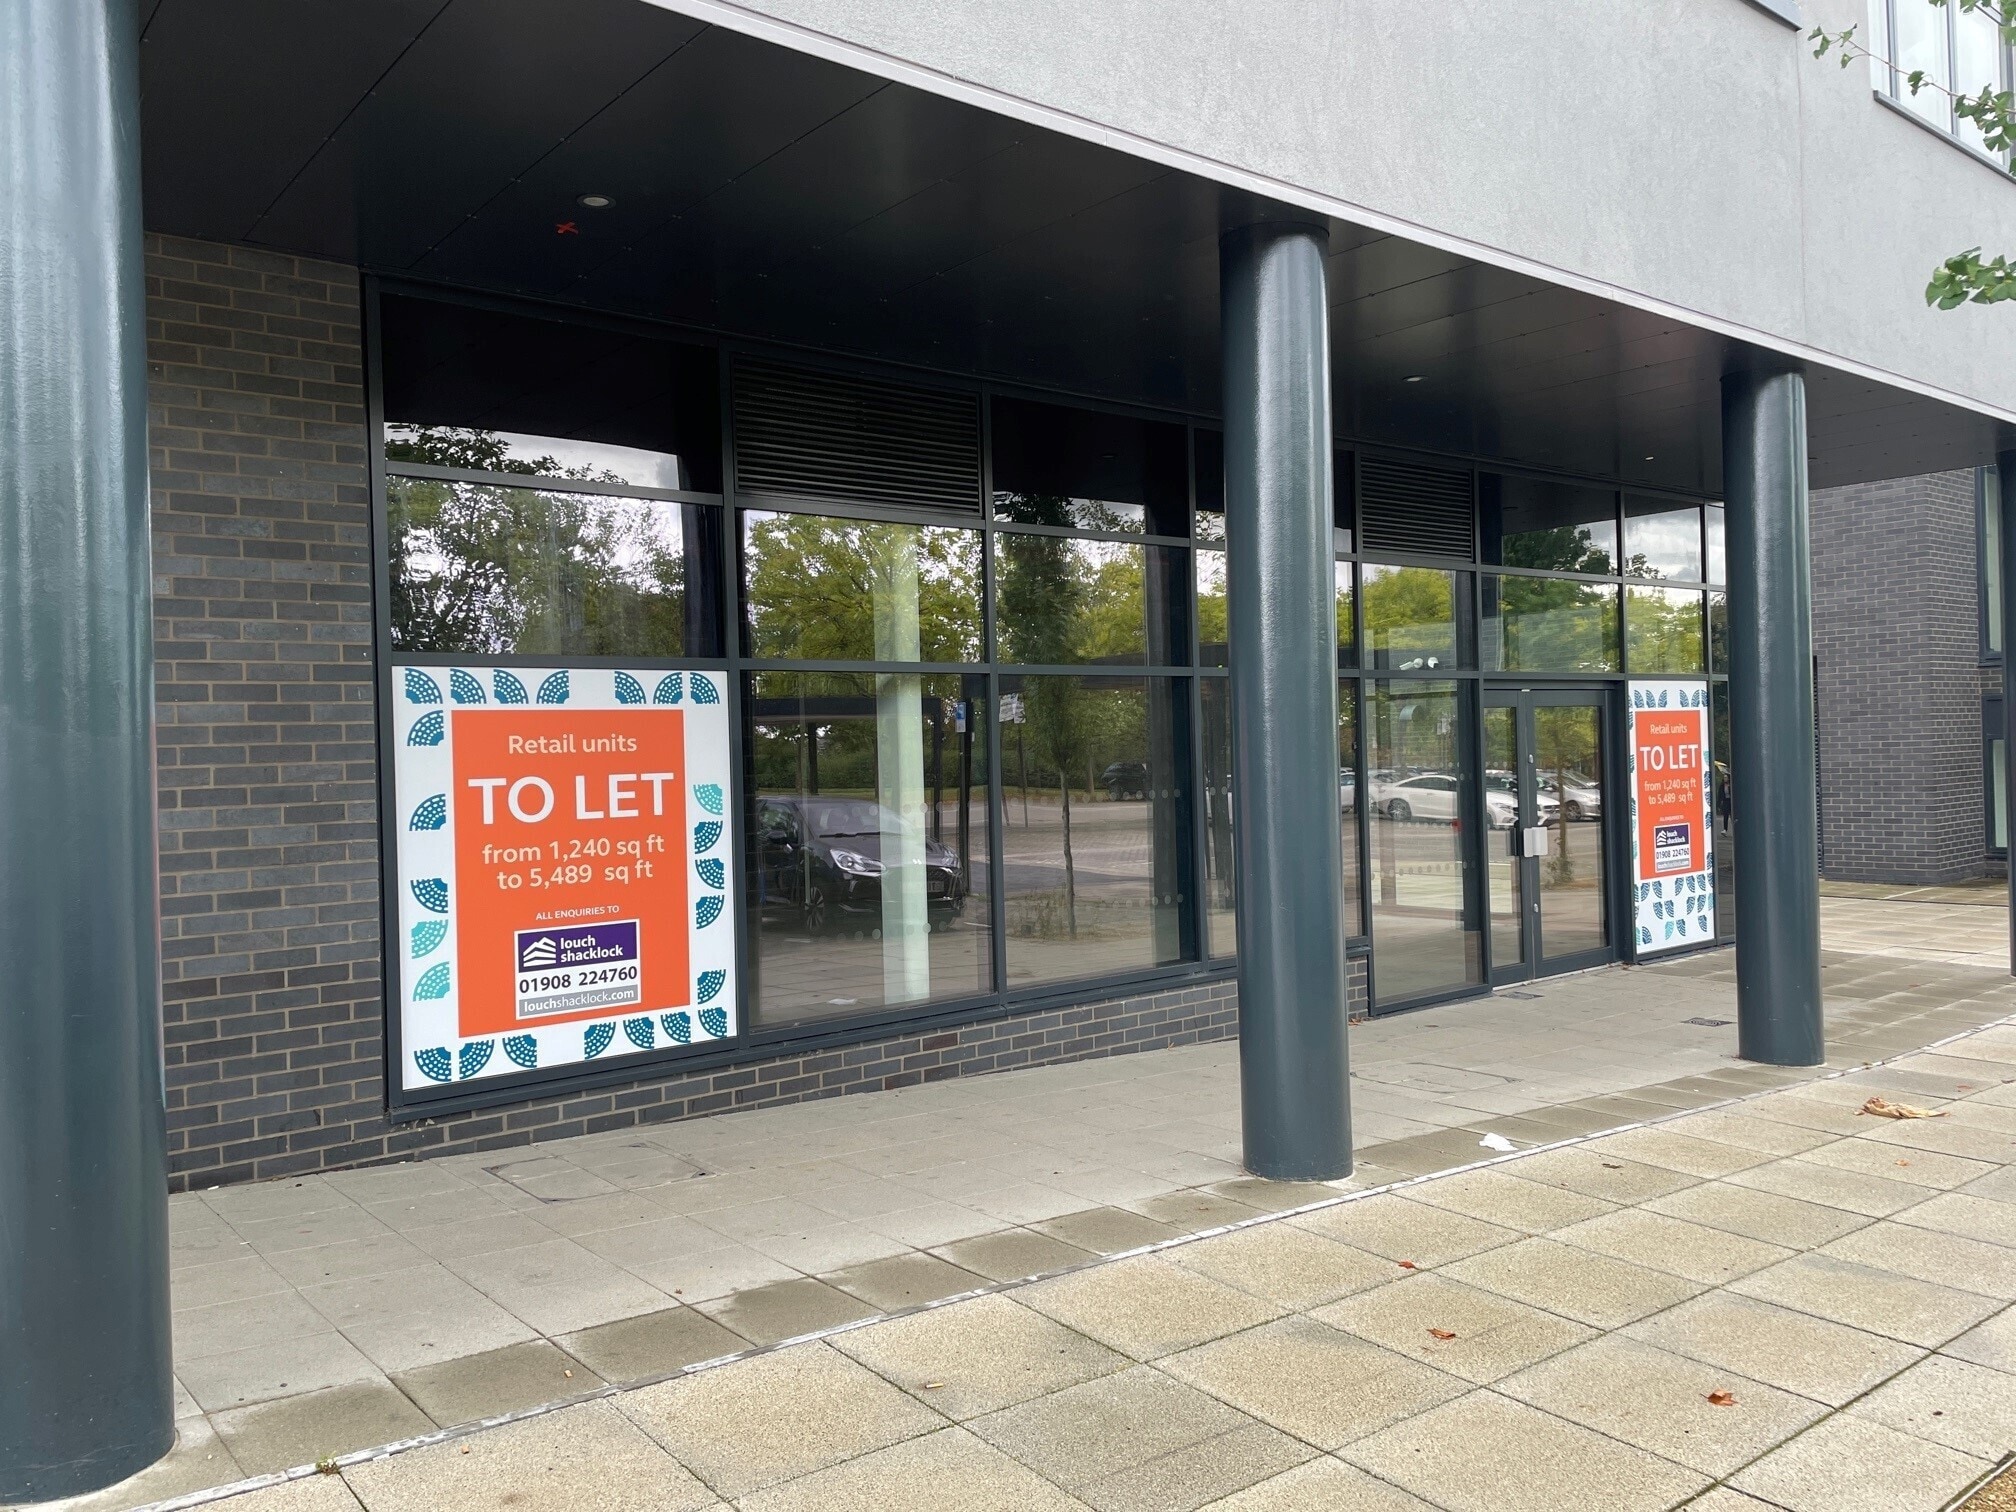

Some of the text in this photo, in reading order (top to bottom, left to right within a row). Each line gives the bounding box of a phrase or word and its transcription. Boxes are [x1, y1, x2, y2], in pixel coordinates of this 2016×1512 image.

[1650, 722, 1688, 735] Retail units
[508, 733, 638, 754] Retail units
[1639, 743, 1699, 771] TO LET
[1644, 777, 1697, 792] from 1,240 sq ft
[467, 772, 674, 825] TO LET
[1648, 791, 1694, 805] to 5,489 sq ft
[482, 833, 665, 865] from 1,240 sq ft
[497, 859, 654, 890] to 5,489 sq ft
[535, 905, 620, 921] ALL ENQUIRIES TO
[560, 934, 596, 950] louch
[560, 944, 624, 963] shacklock
[519, 965, 638, 994] 01908 224760
[524, 989, 635, 1012] louchshacklock.com
